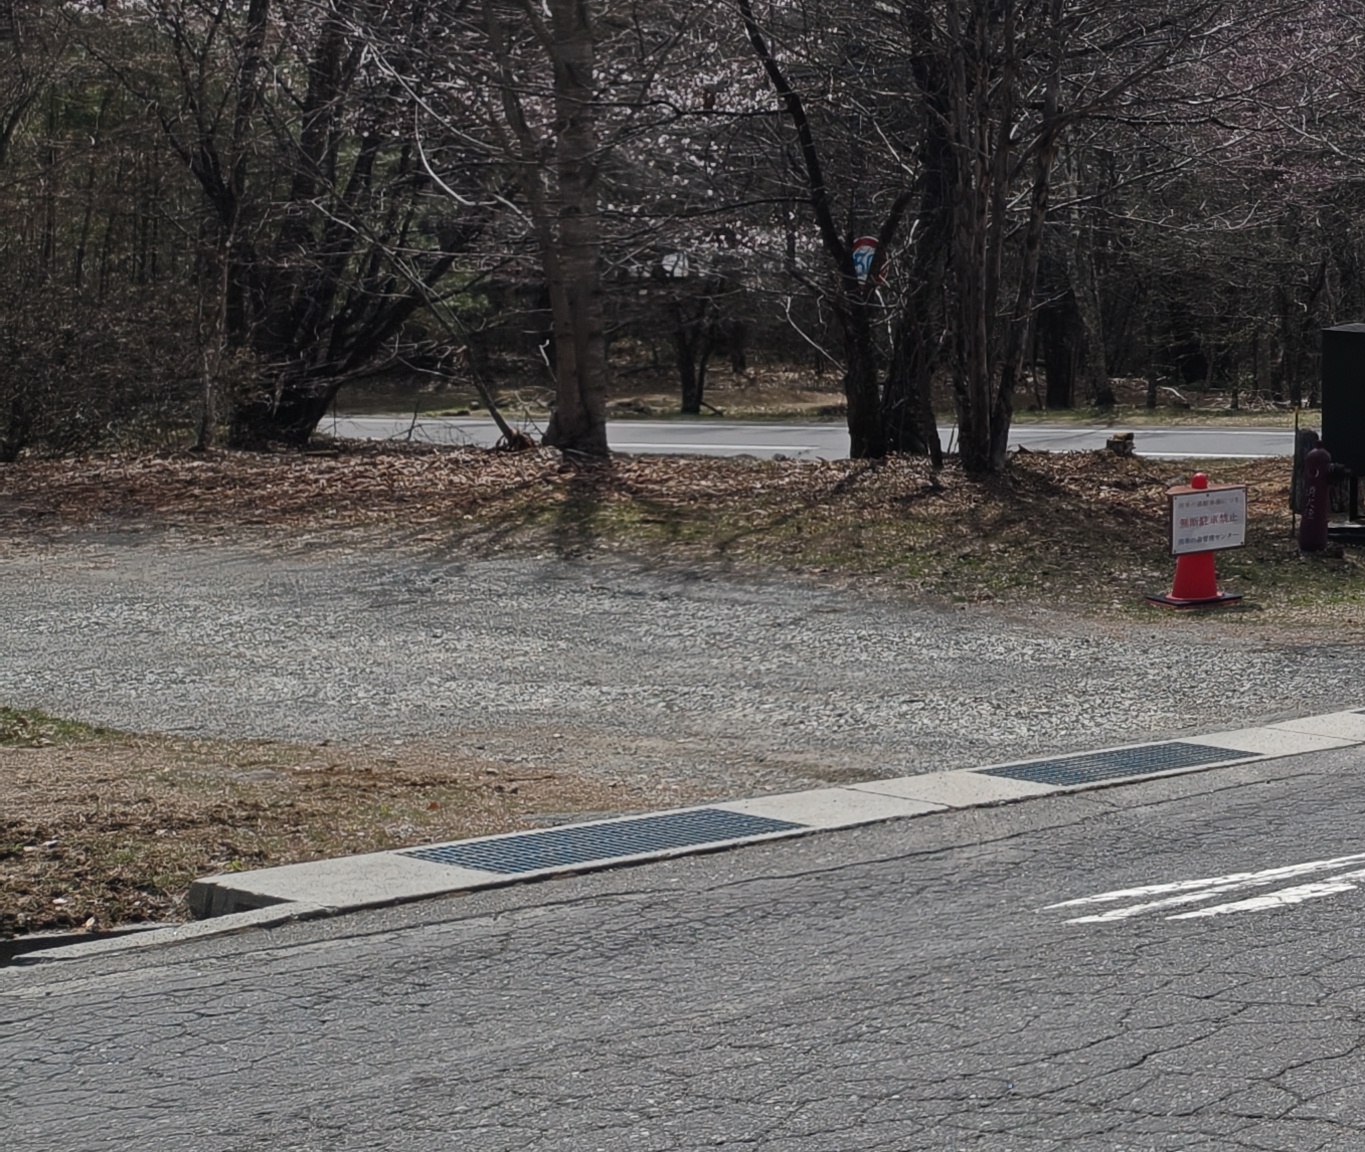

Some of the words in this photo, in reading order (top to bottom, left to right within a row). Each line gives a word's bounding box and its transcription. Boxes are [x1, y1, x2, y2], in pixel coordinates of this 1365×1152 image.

[1179, 512, 1239, 528] 無断駐車禁止
